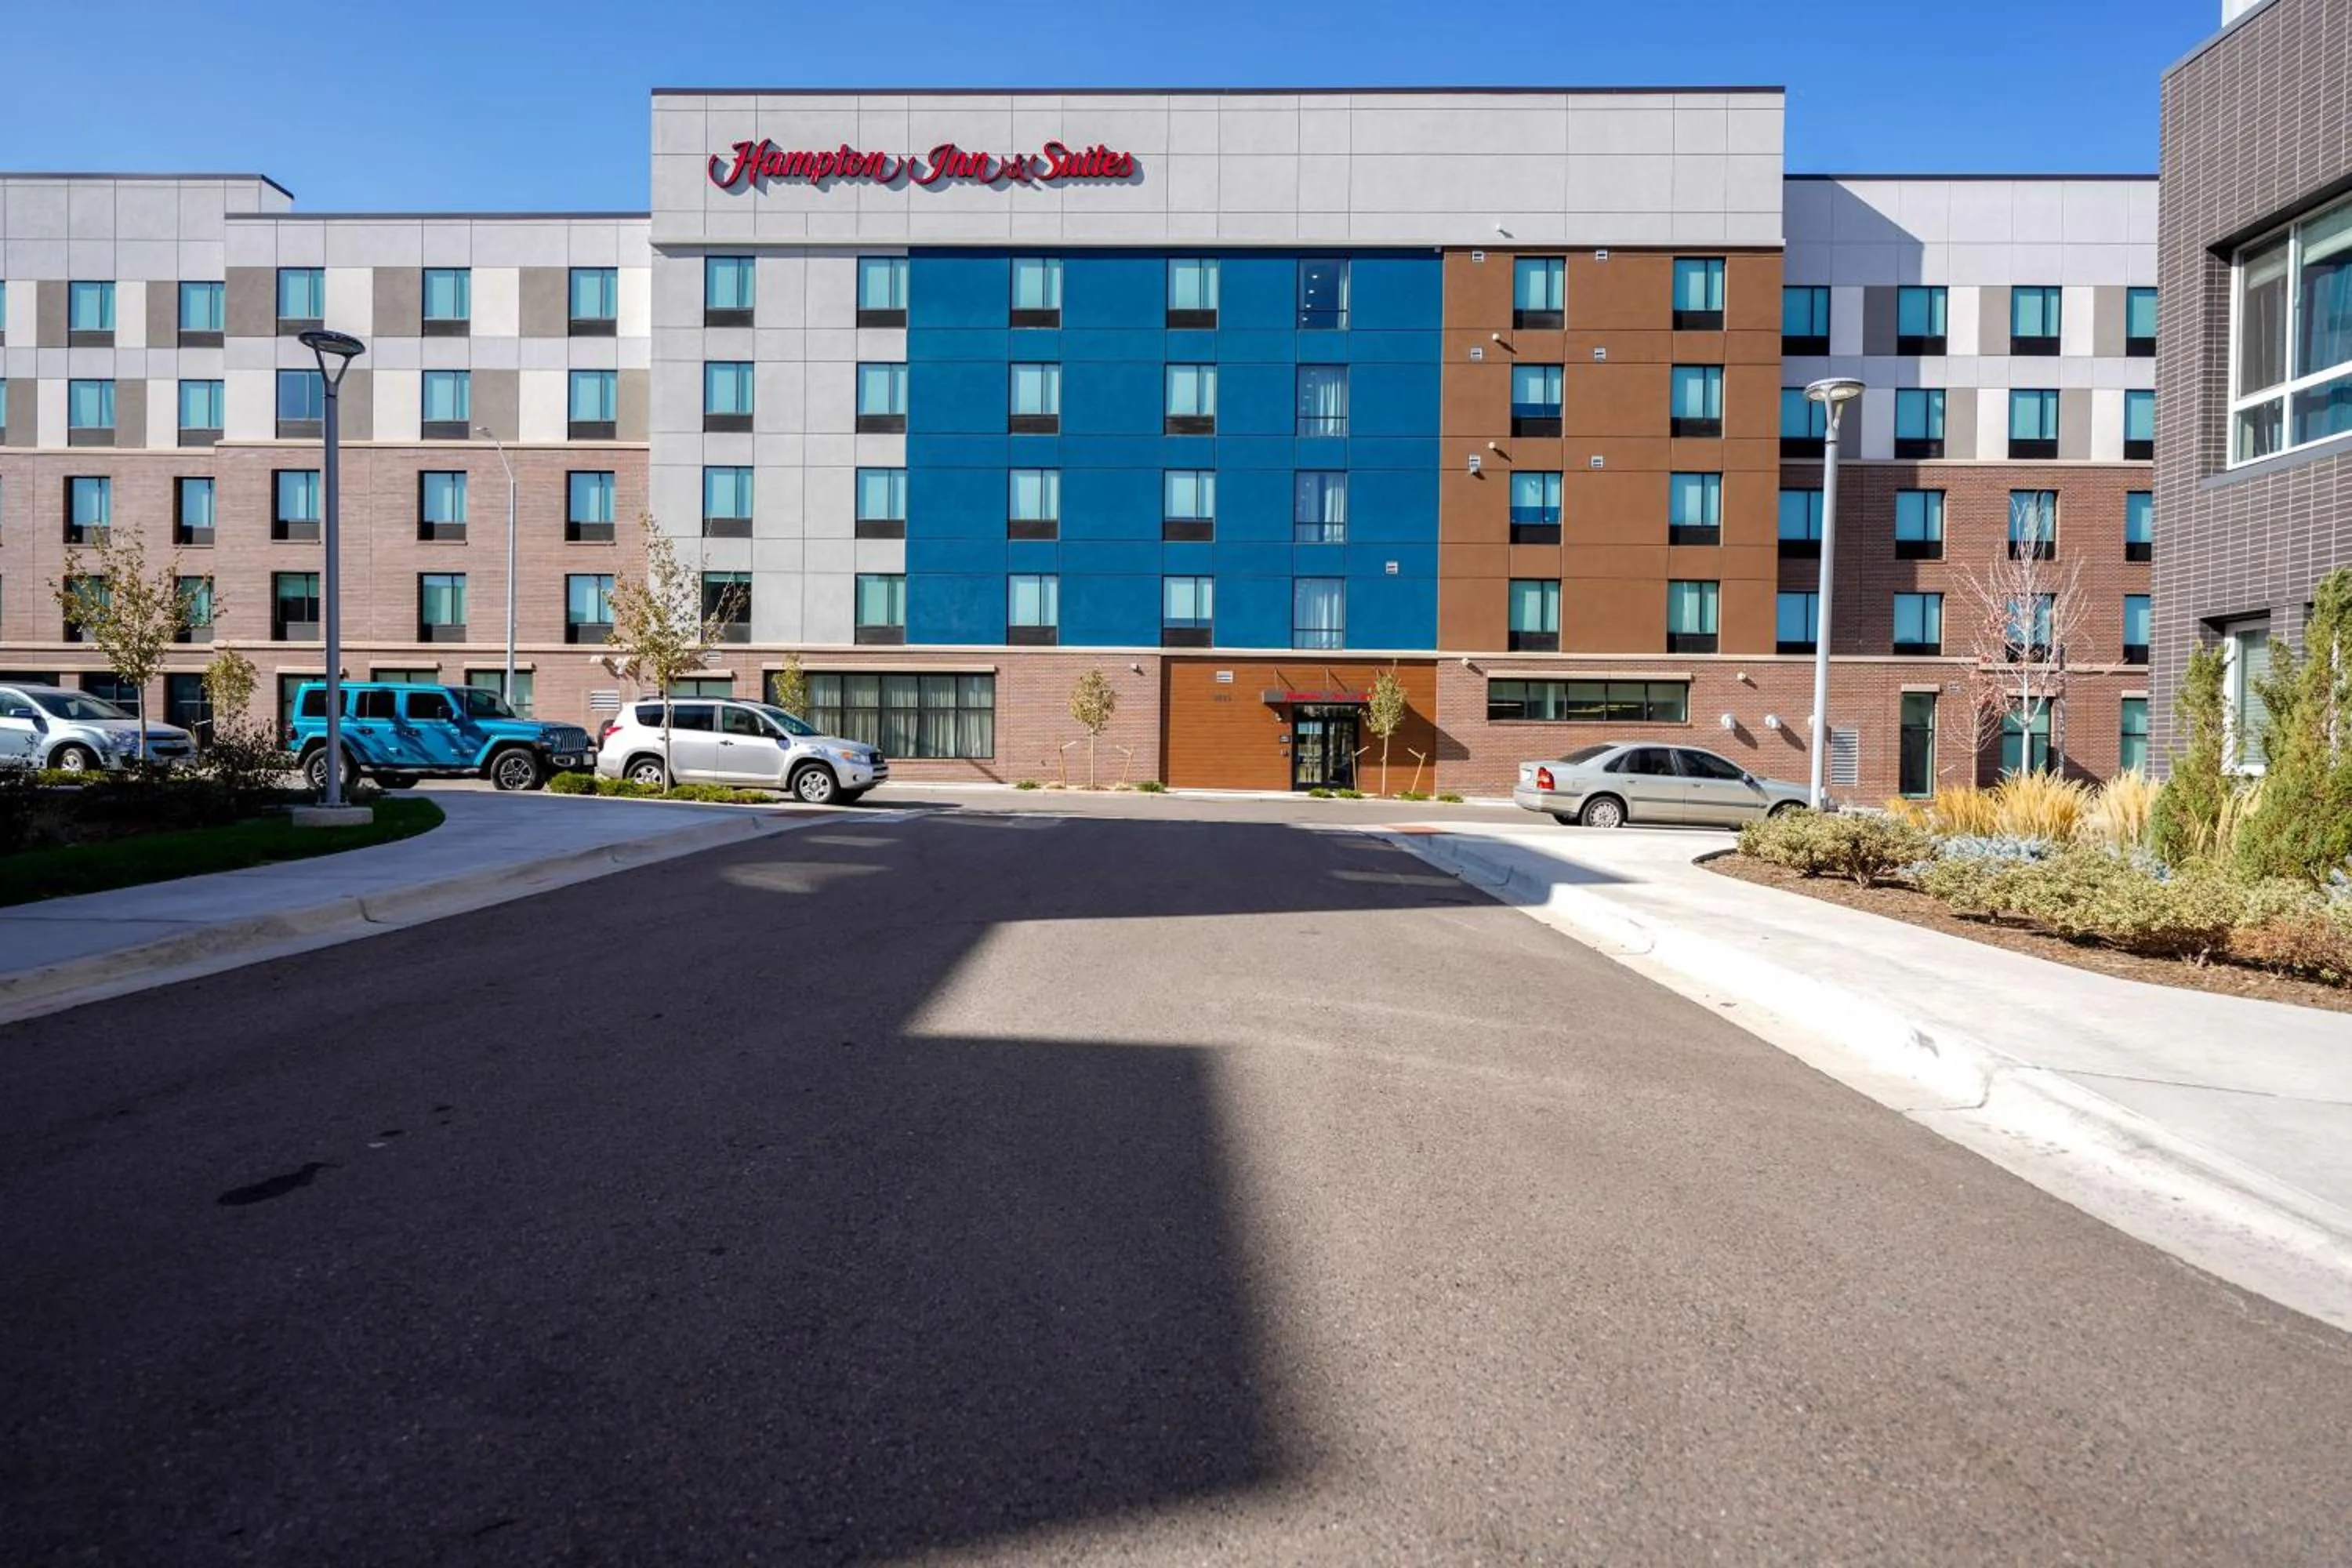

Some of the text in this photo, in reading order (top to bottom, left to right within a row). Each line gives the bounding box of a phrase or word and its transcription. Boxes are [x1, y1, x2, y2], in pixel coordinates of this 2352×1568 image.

[708, 138, 1134, 188] Hampton Inn & Suites
